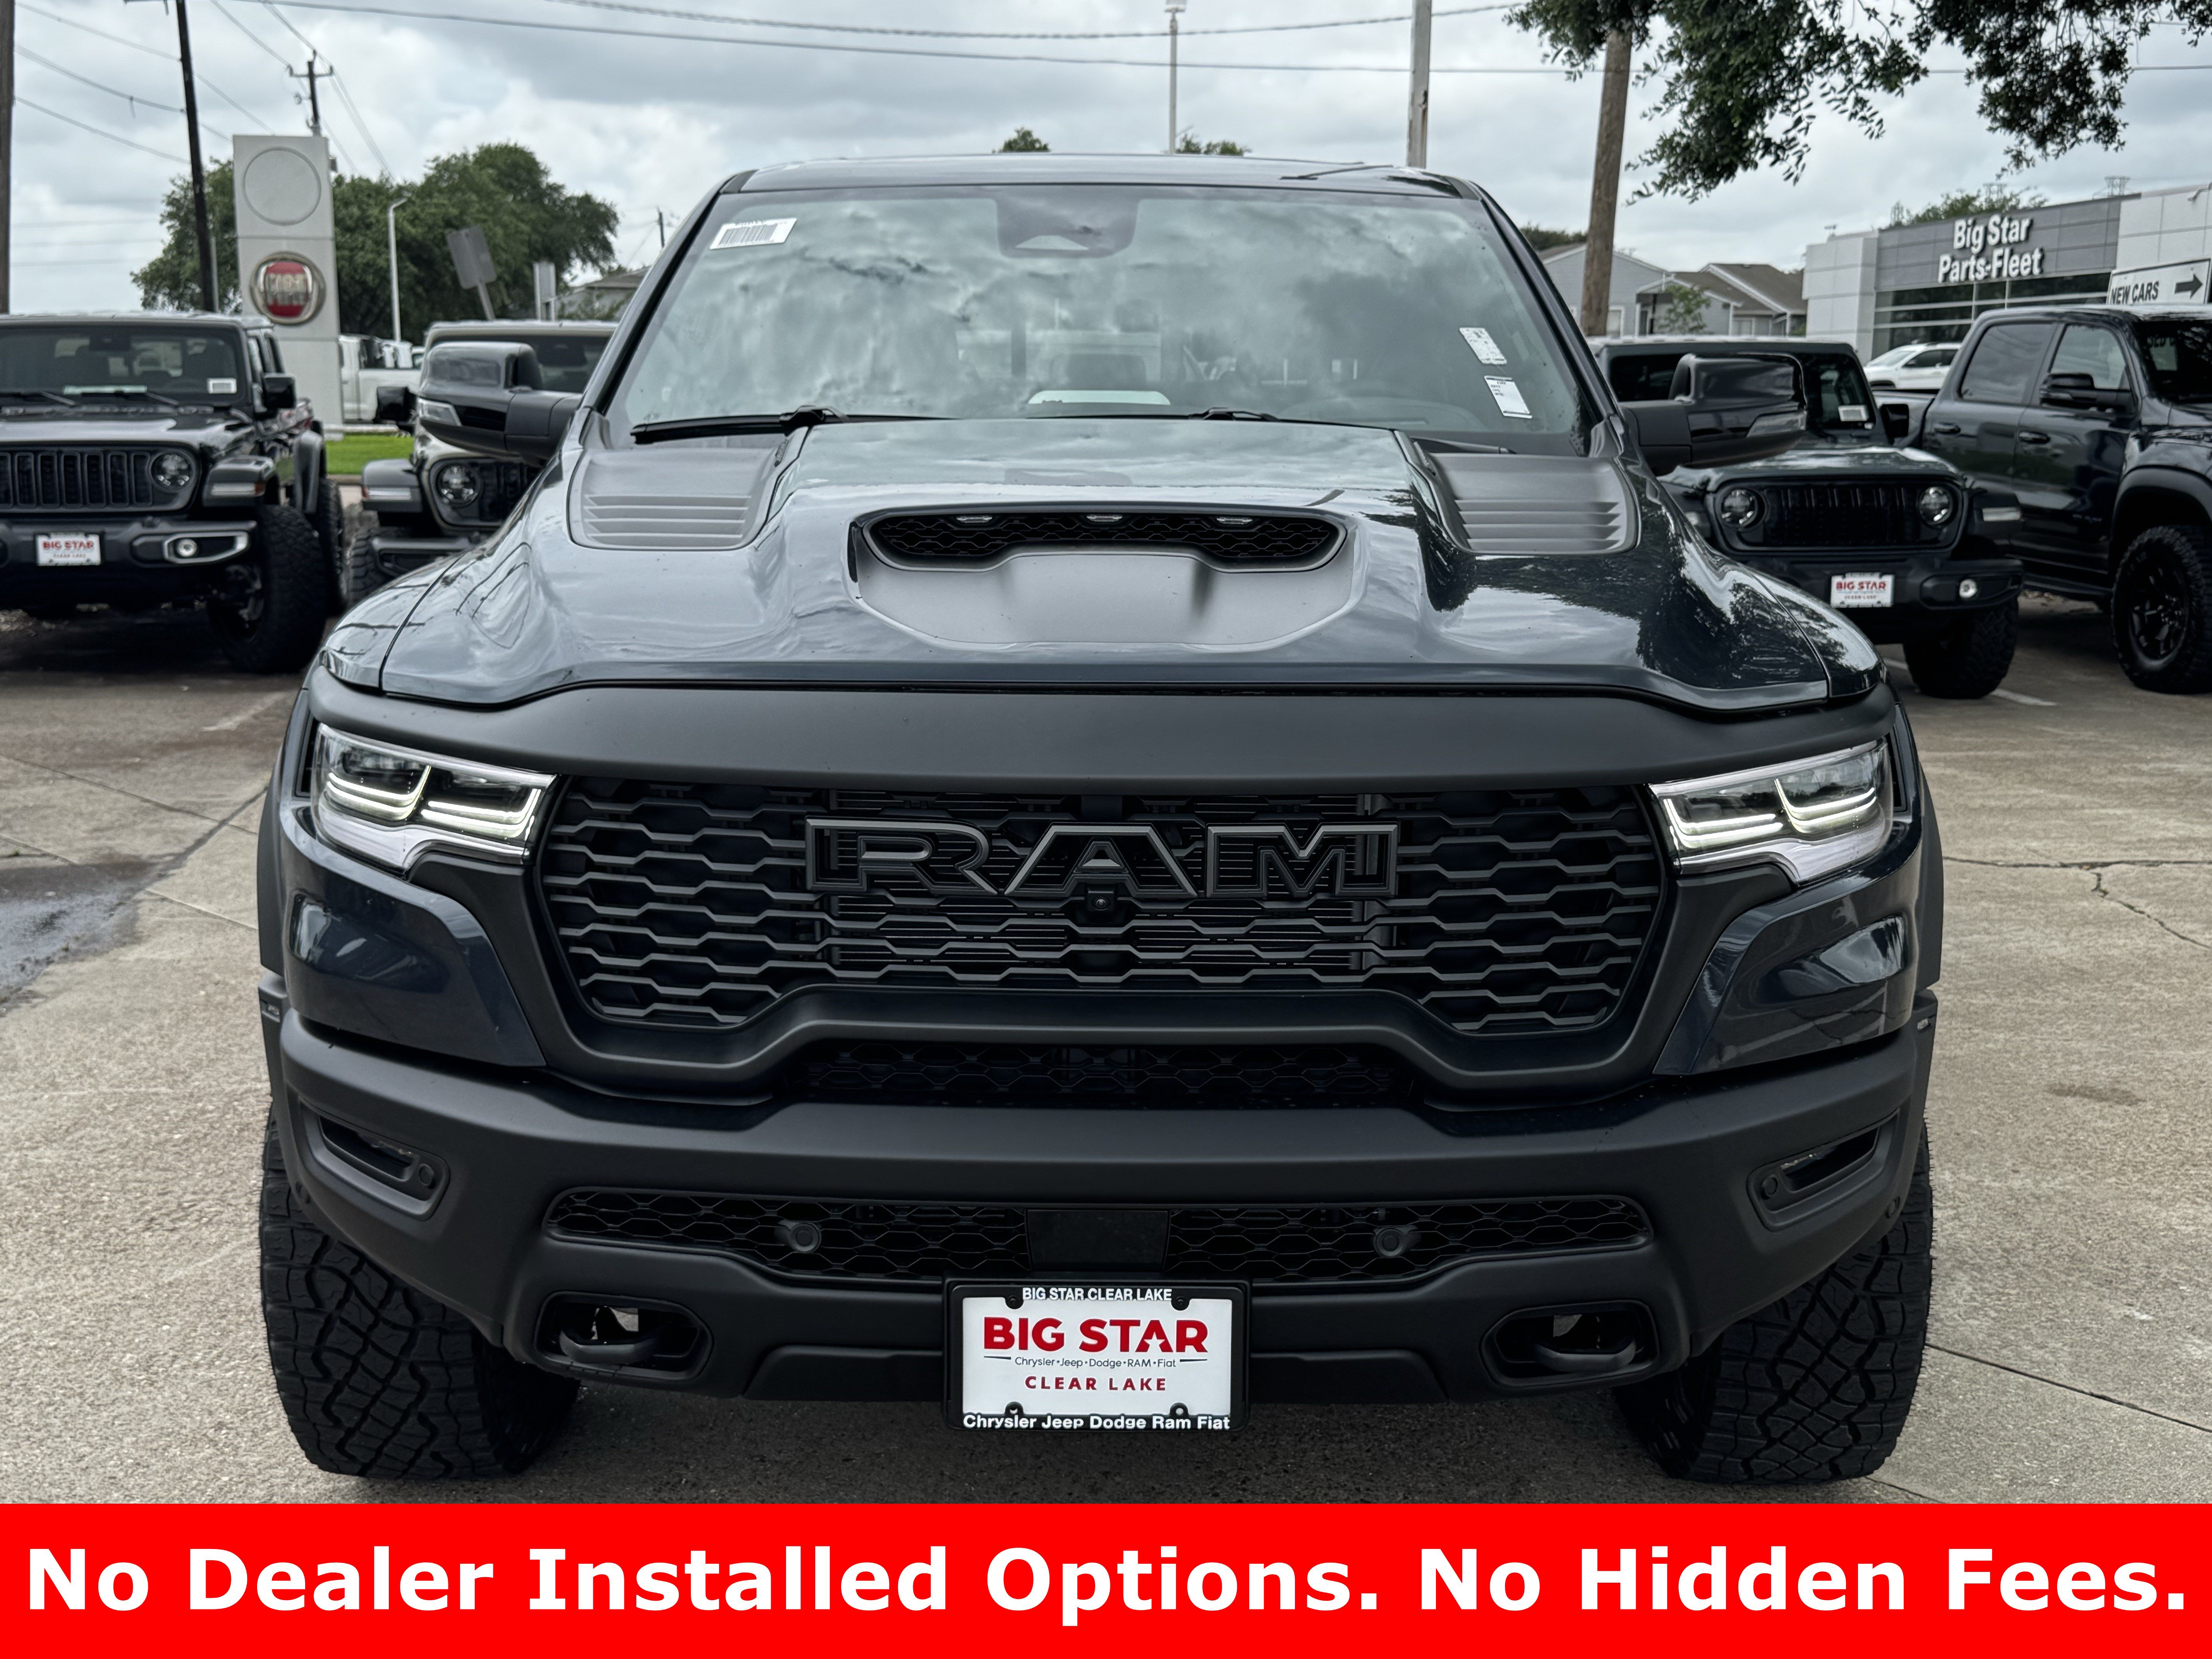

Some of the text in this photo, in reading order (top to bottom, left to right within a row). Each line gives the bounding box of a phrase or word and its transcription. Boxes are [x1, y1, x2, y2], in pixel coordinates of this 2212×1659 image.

[1953, 214, 2031, 254] Big Star
[1938, 247, 2042, 283] Parts-Fleet
[2111, 280, 2159, 304] NEW CARS
[43, 541, 94, 550] BIG STAR
[1836, 581, 1886, 591] BIG STAR
[805, 816, 1399, 898] RAM
[1023, 1288, 1172, 1301] BIG STAR CLEAR LAKE
[984, 1317, 1208, 1353] BIG STAR
[1025, 1376, 1166, 1391] CLEAR LAKE
[963, 1415, 1230, 1430] Chrysler Jeep Dodge Ram Fiat
